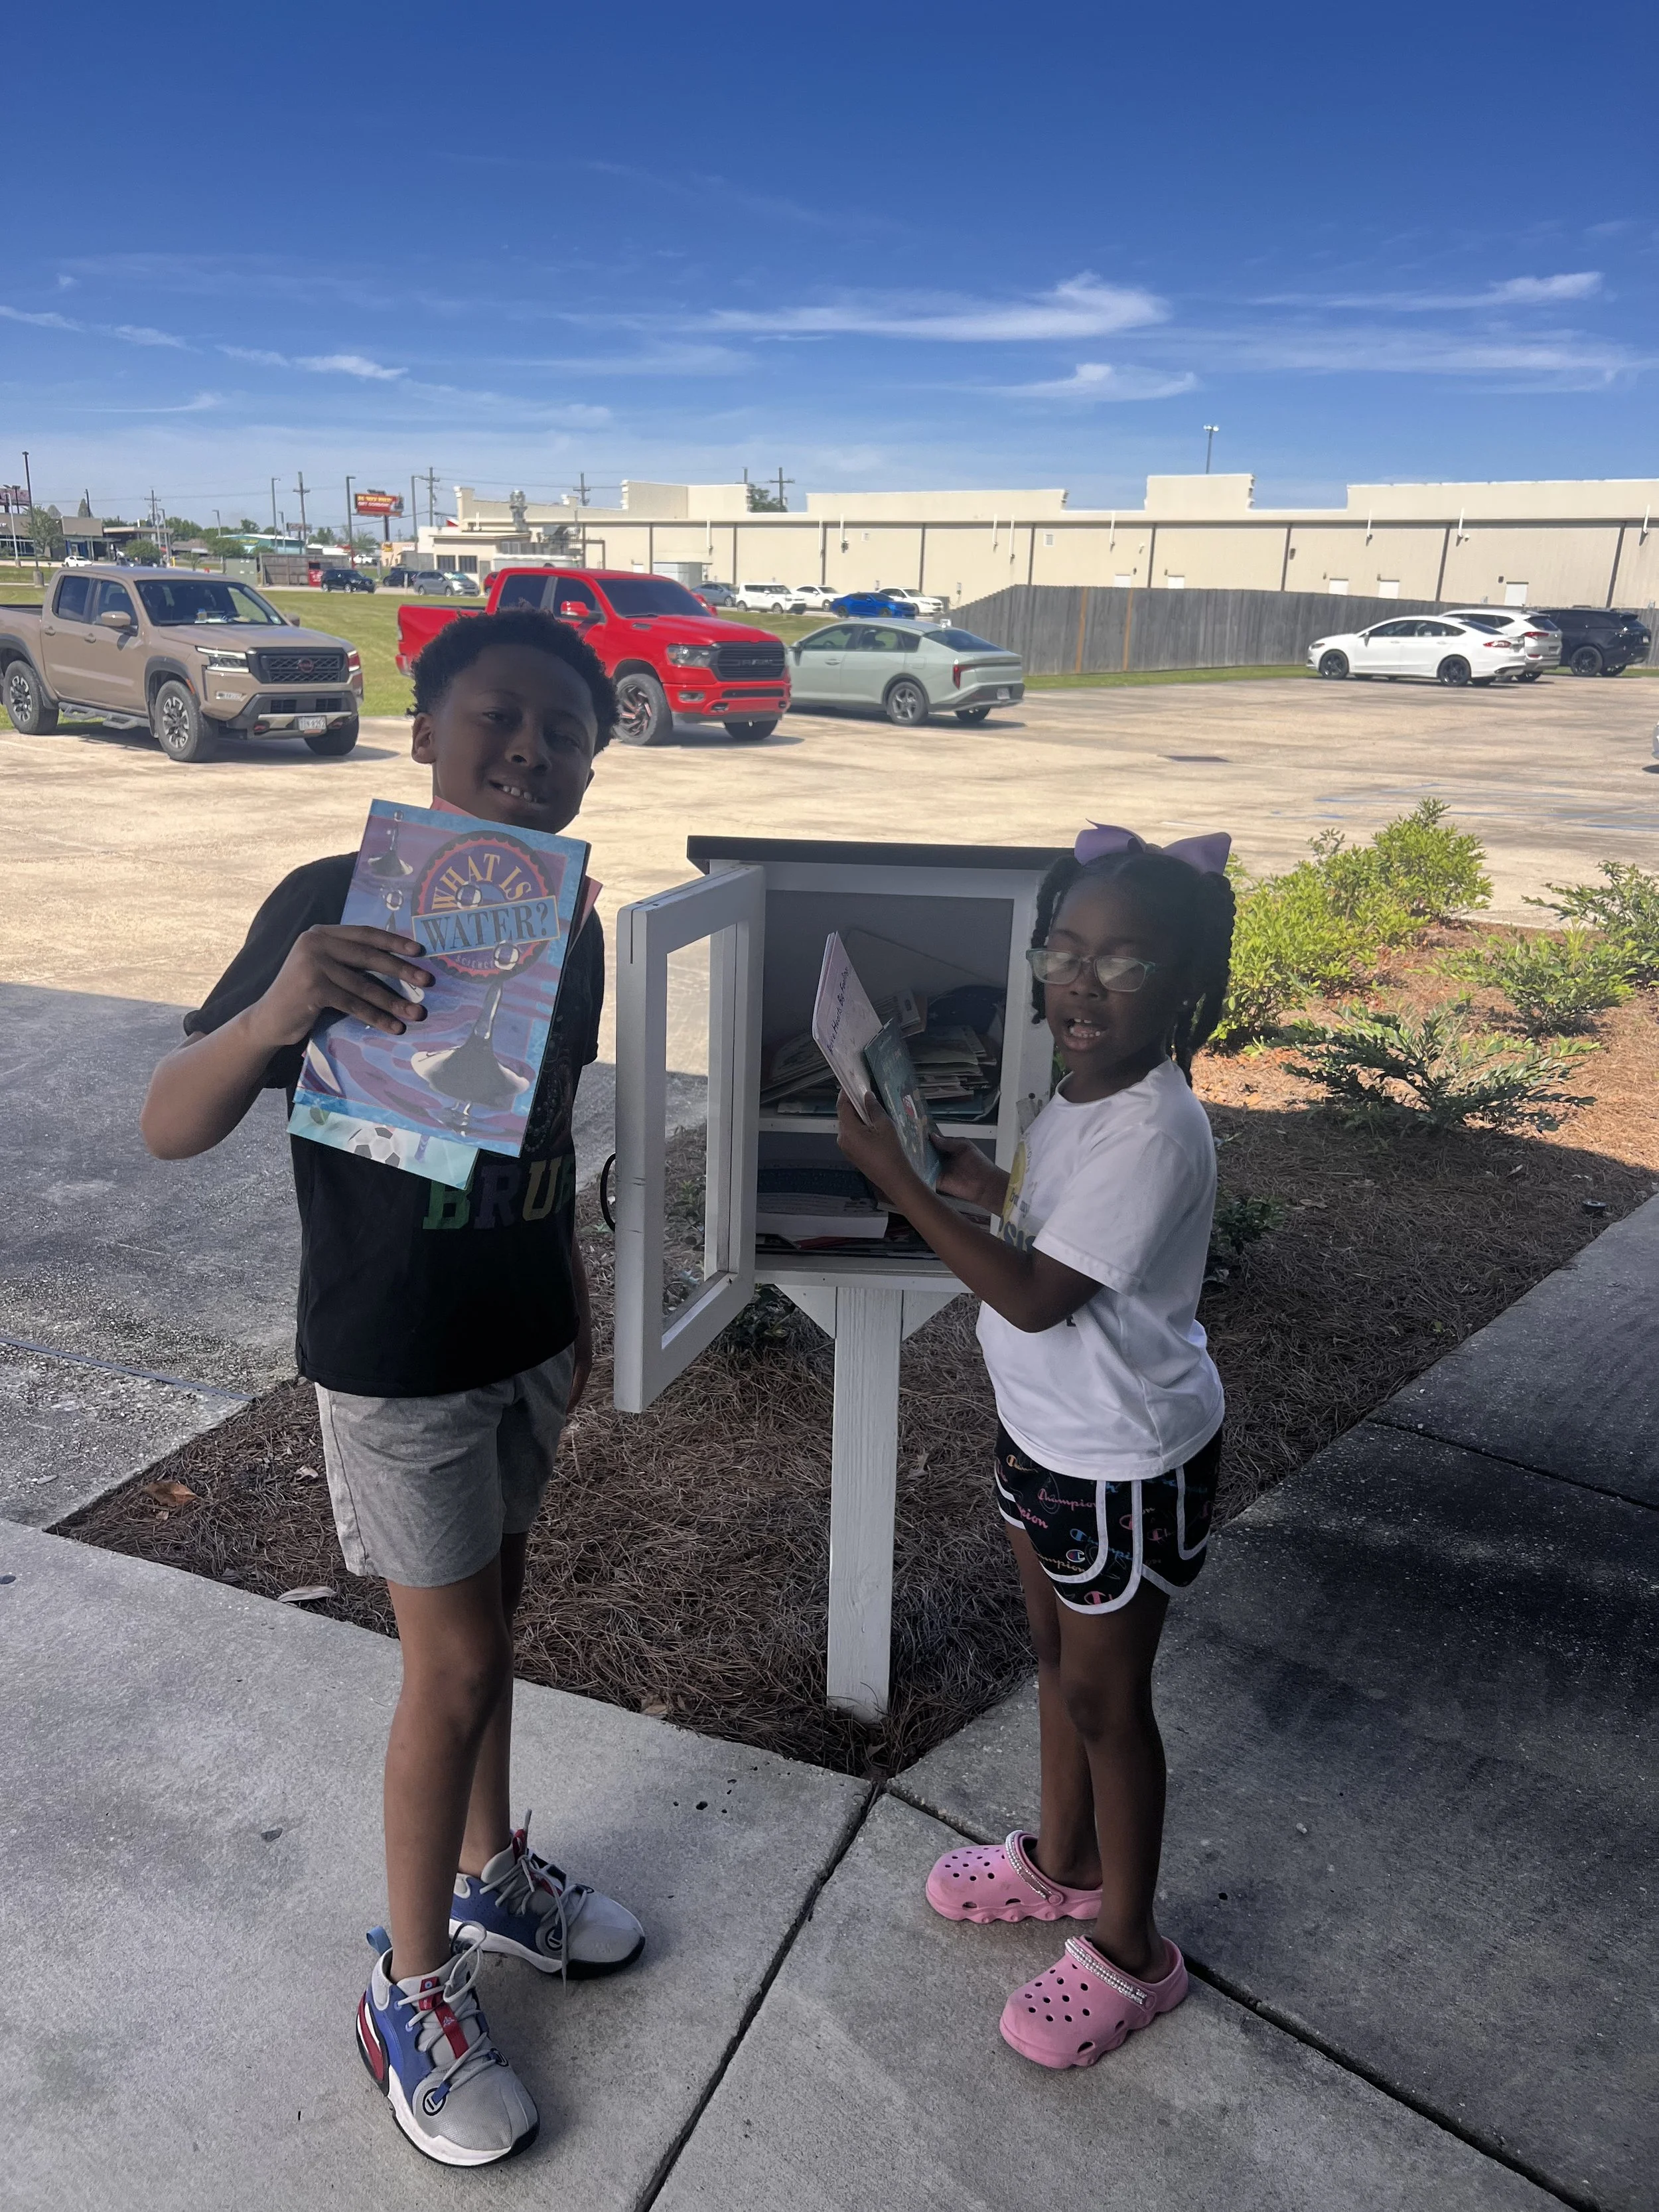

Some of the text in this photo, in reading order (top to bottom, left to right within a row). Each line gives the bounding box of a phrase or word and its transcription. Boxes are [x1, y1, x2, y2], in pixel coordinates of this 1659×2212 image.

[431, 853, 532, 910] WHAT IS
[420, 902, 548, 952] WATER?
